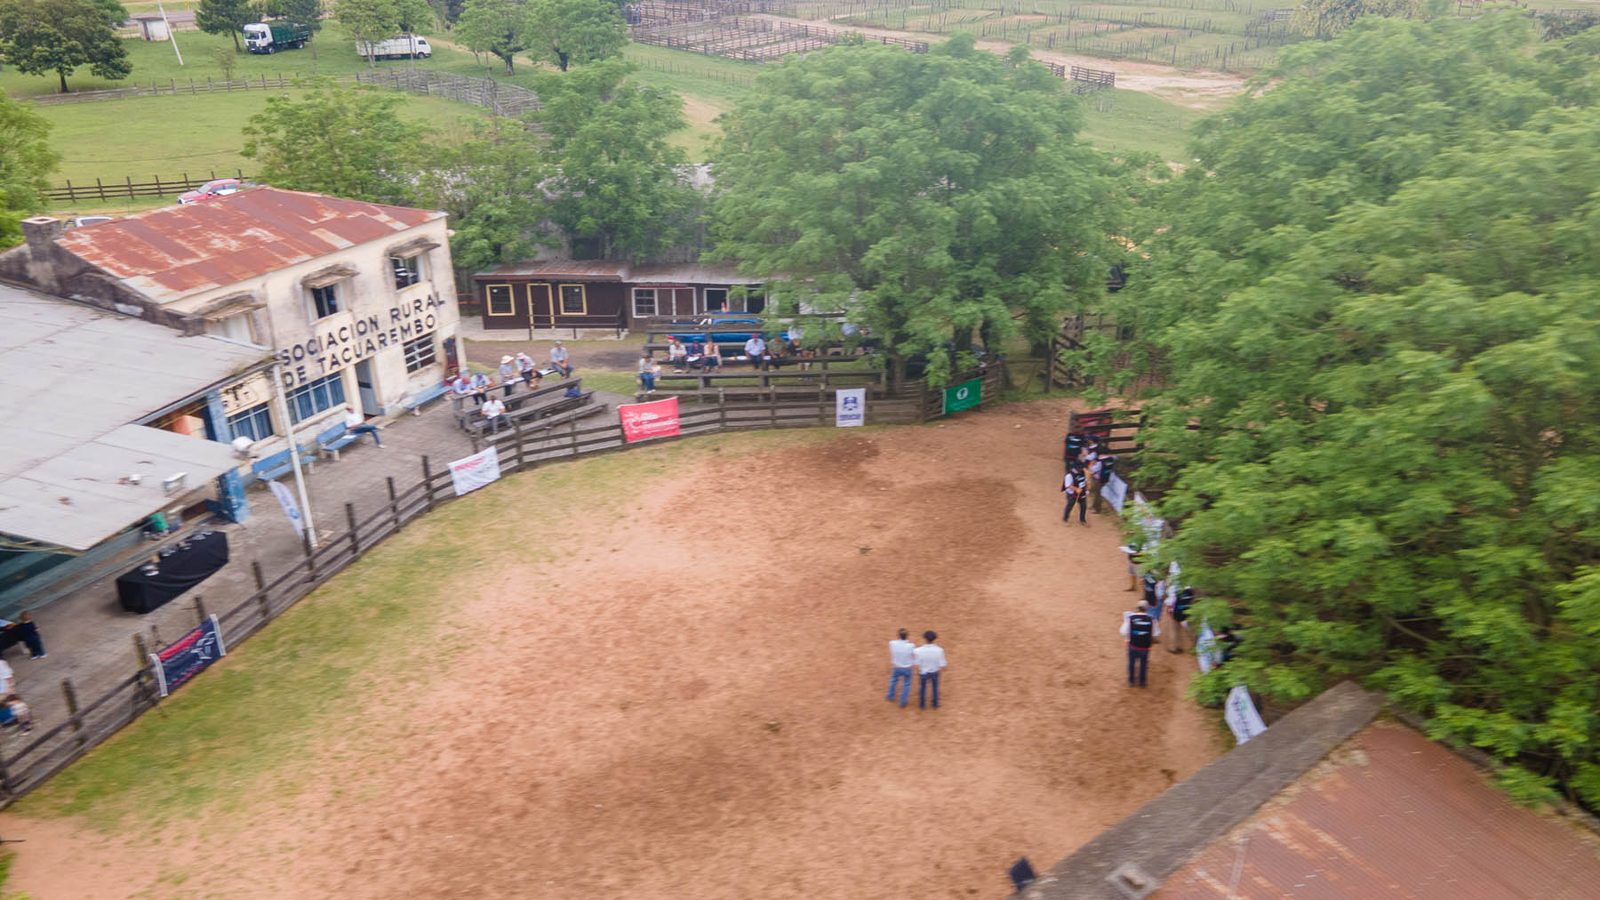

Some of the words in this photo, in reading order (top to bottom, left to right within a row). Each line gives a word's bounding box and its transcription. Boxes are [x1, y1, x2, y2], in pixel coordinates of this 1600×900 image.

[280, 314, 380, 366] SOCIACION
[390, 293, 445, 323] RURAL
[282, 365, 307, 388] DE
[317, 314, 436, 374] TACUAREMBO
